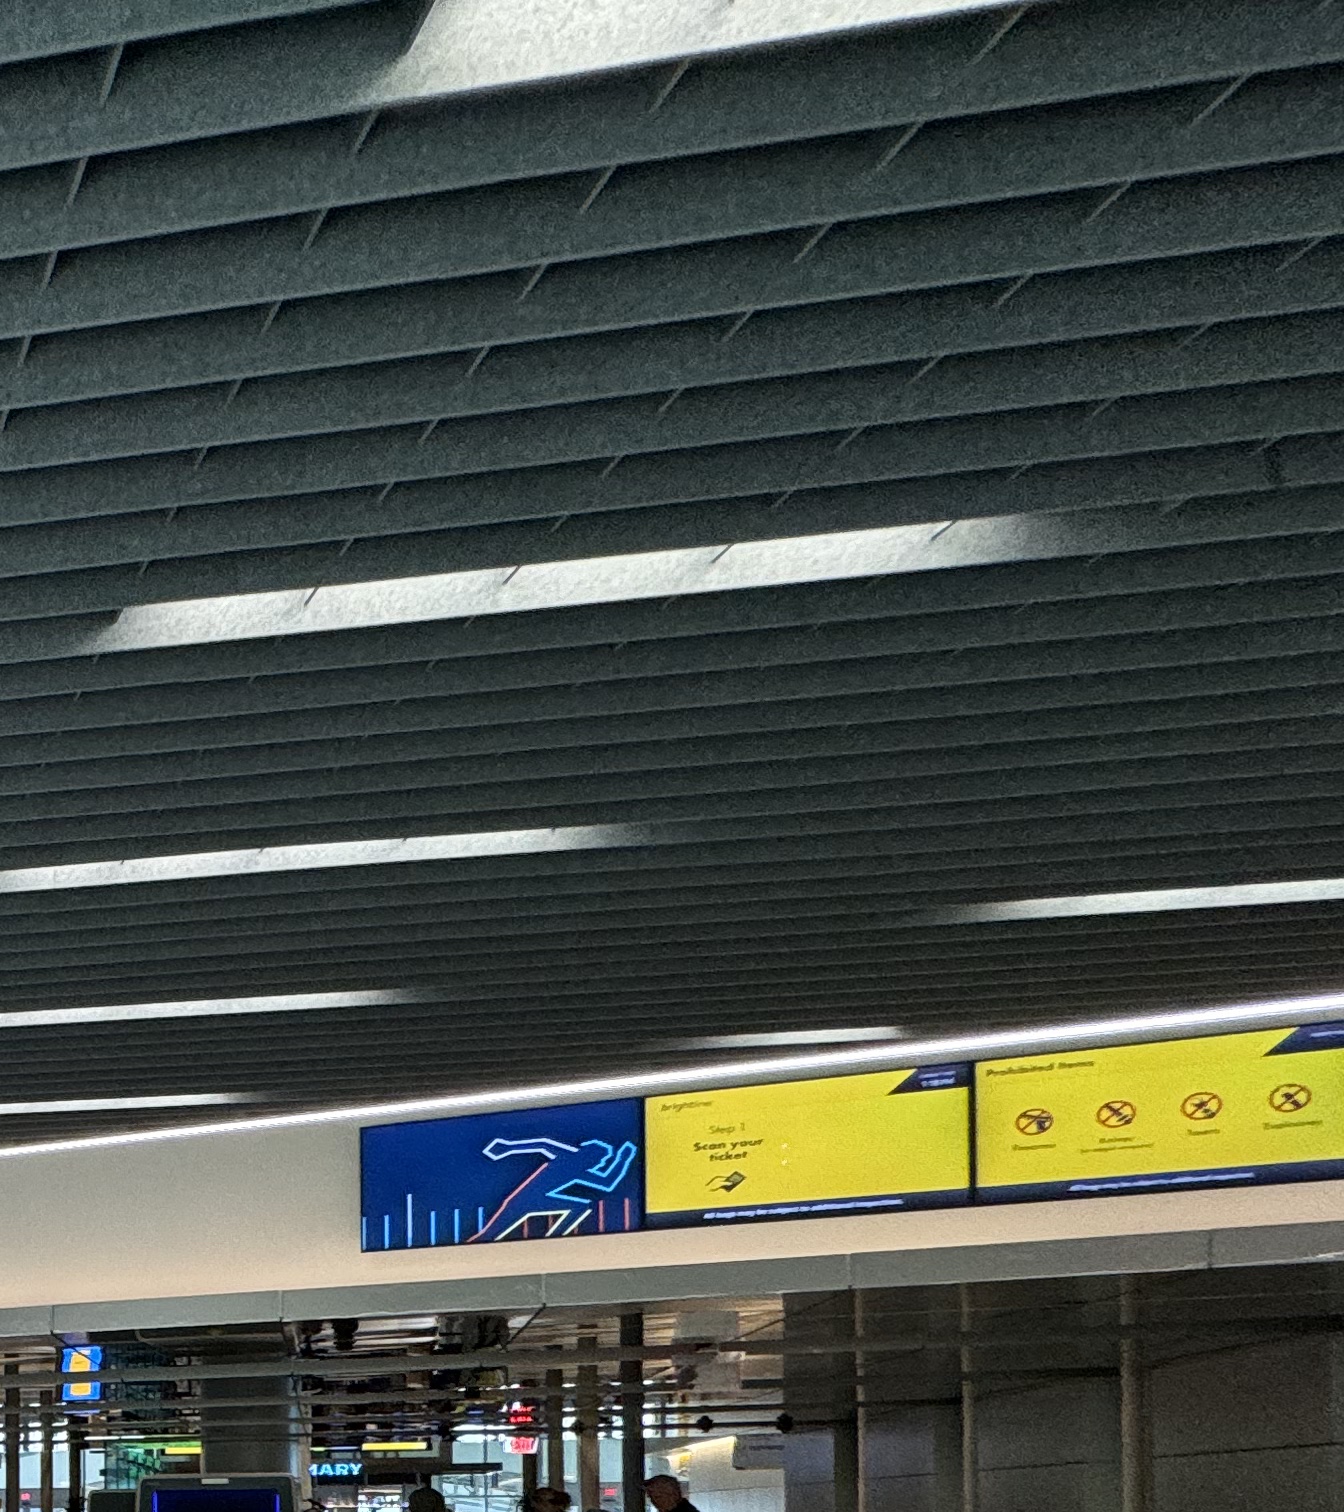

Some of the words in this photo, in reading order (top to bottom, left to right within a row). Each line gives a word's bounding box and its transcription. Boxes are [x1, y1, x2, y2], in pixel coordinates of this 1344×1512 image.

[693, 1142, 726, 1152] Scan
[730, 1139, 764, 1151] your
[709, 1151, 748, 1162] ticket
